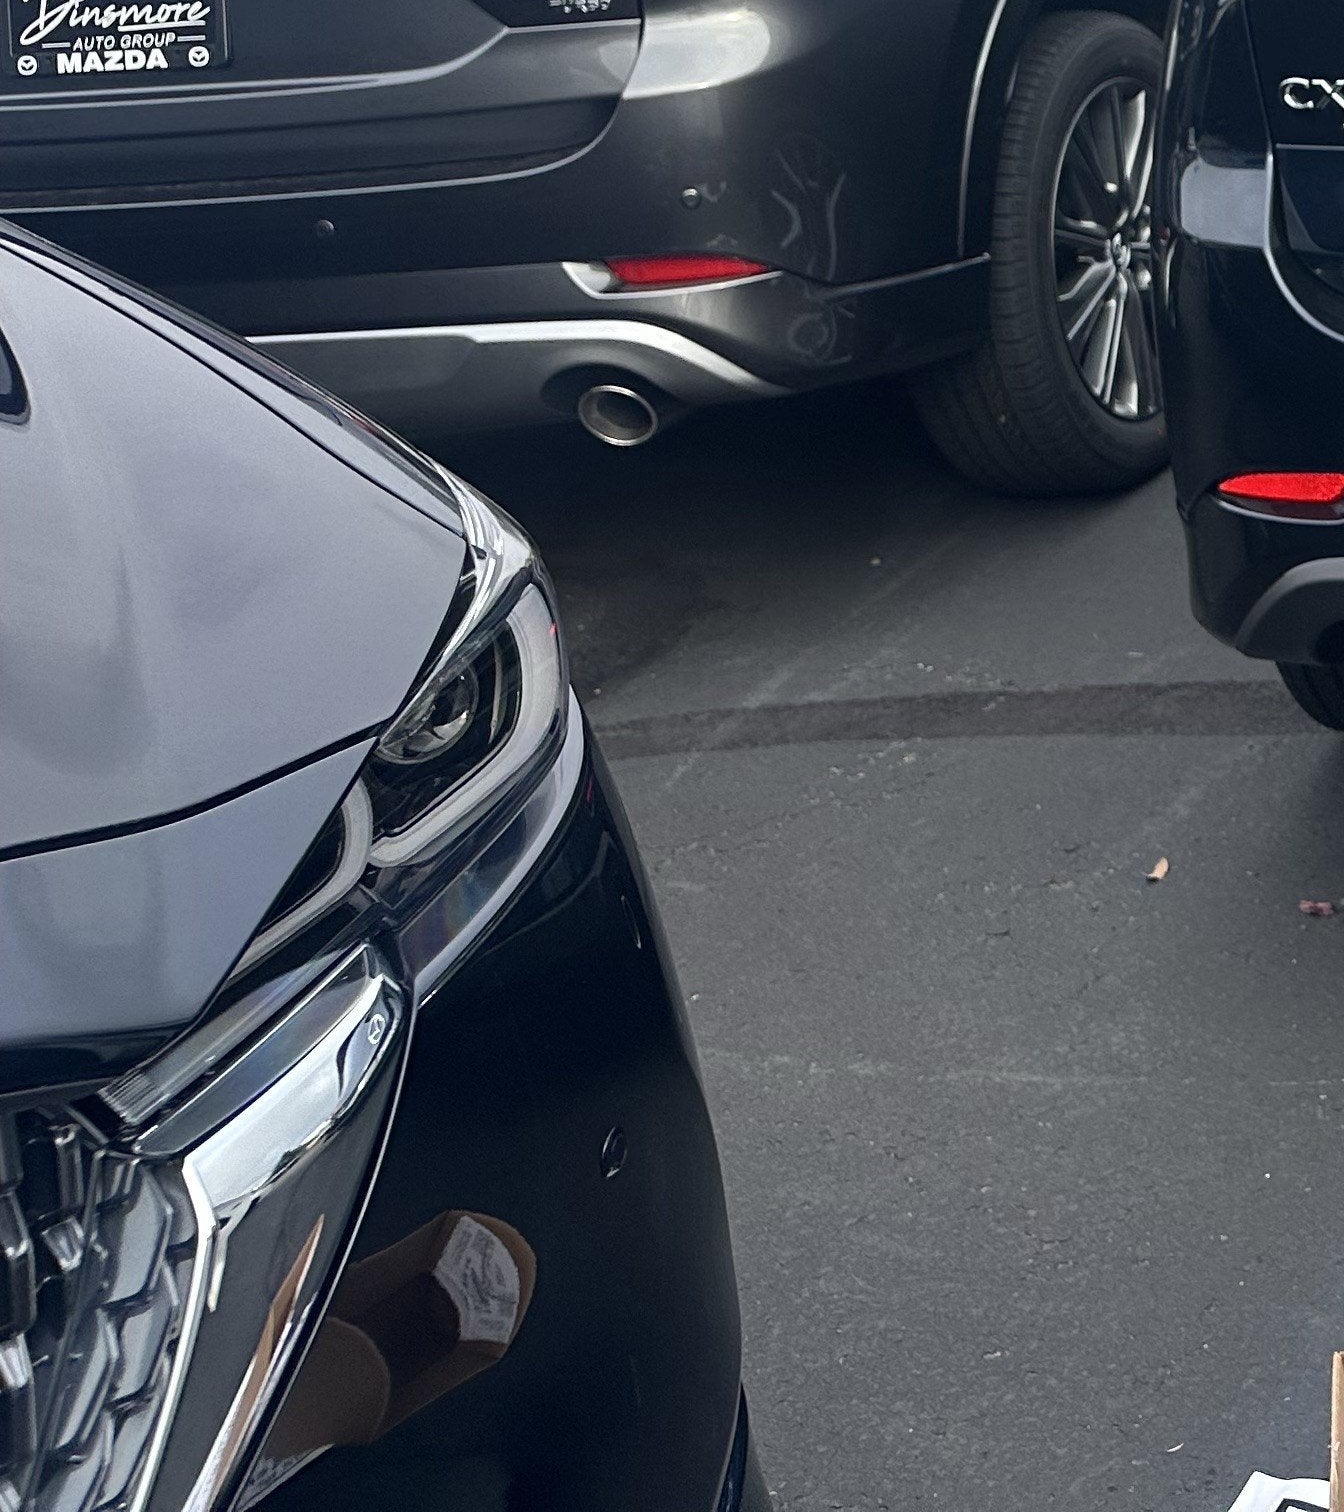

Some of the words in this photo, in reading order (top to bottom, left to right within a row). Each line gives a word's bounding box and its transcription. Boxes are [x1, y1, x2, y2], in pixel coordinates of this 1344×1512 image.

[72, 35, 116, 52] AUTO
[120, 32, 176, 49] GROUP
[56, 48, 169, 75] MAZDA
